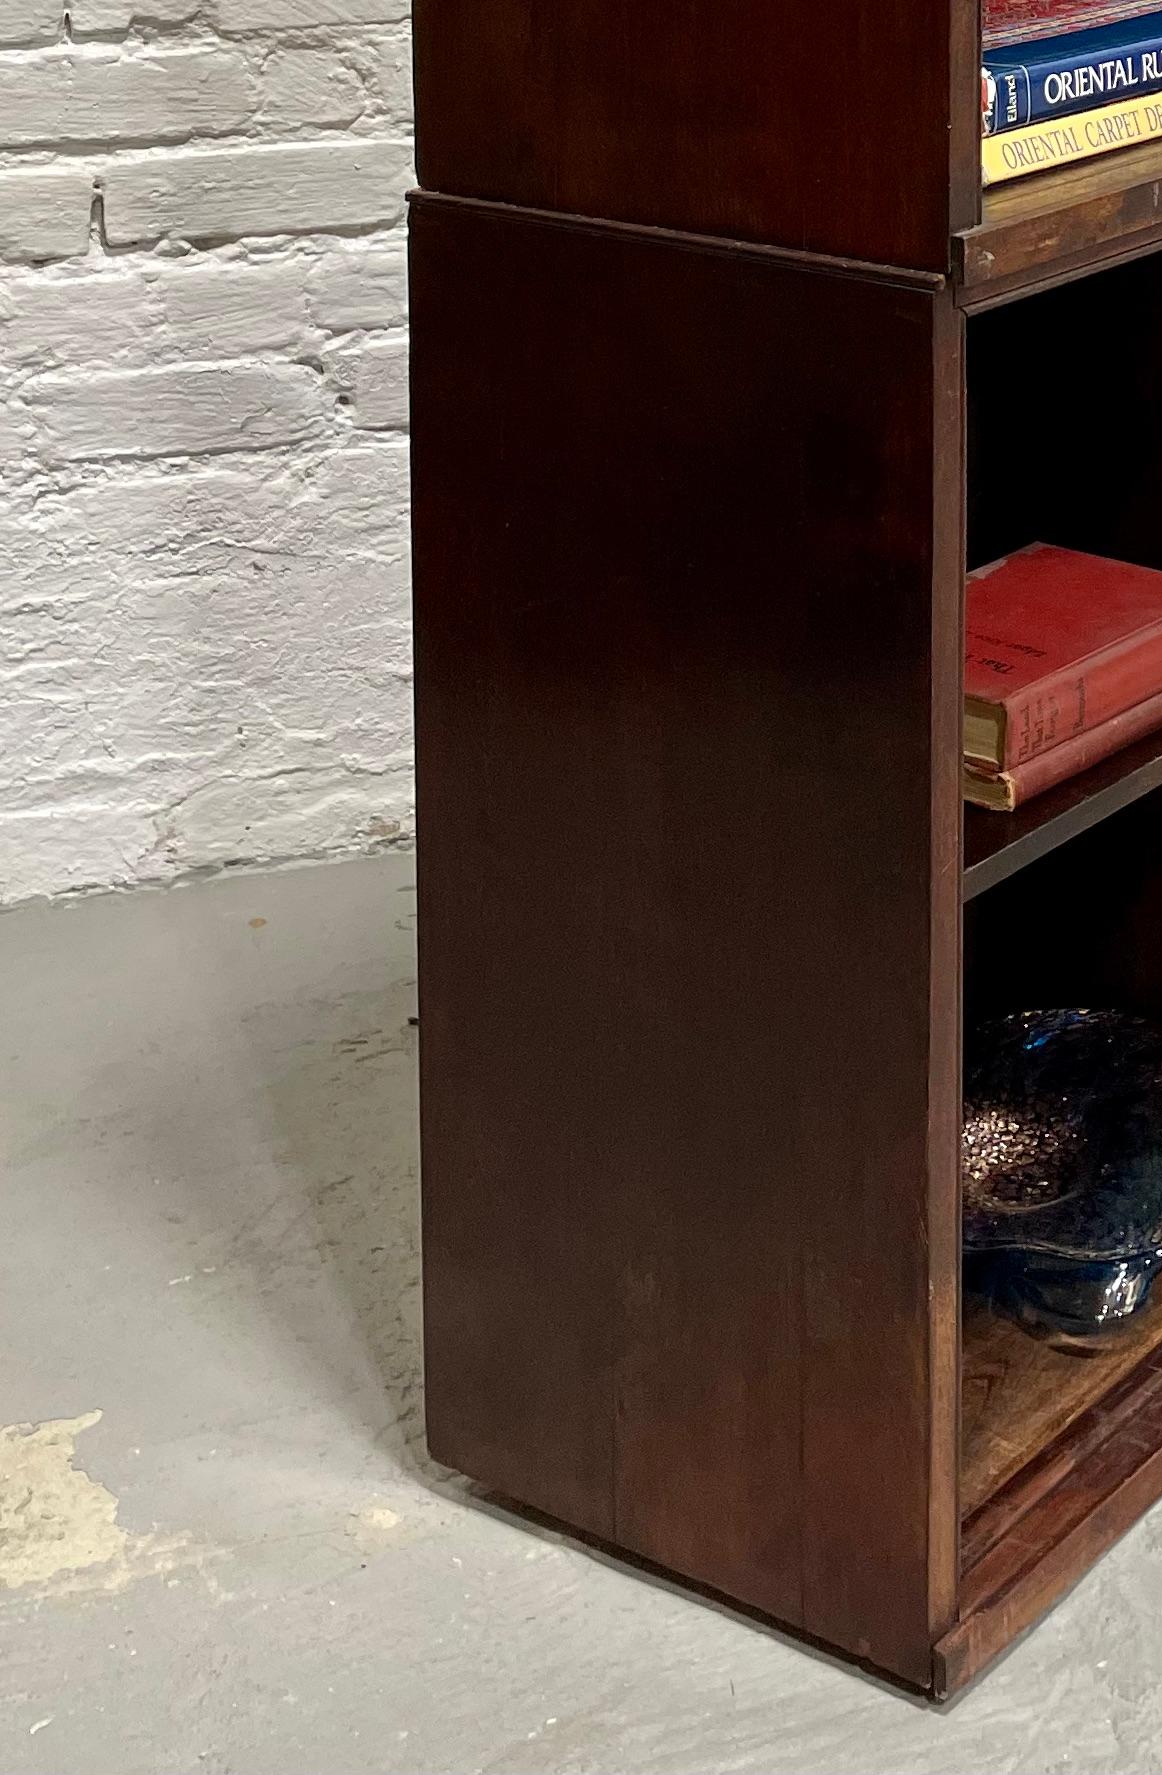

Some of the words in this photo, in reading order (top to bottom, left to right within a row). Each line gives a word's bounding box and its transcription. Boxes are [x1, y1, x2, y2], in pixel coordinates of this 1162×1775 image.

[1007, 74, 1018, 123] Eiland
[1044, 61, 1138, 105] ORIENTAL
[1002, 127, 1084, 170] ORIENTAL
[1084, 109, 1142, 148] CARPET
